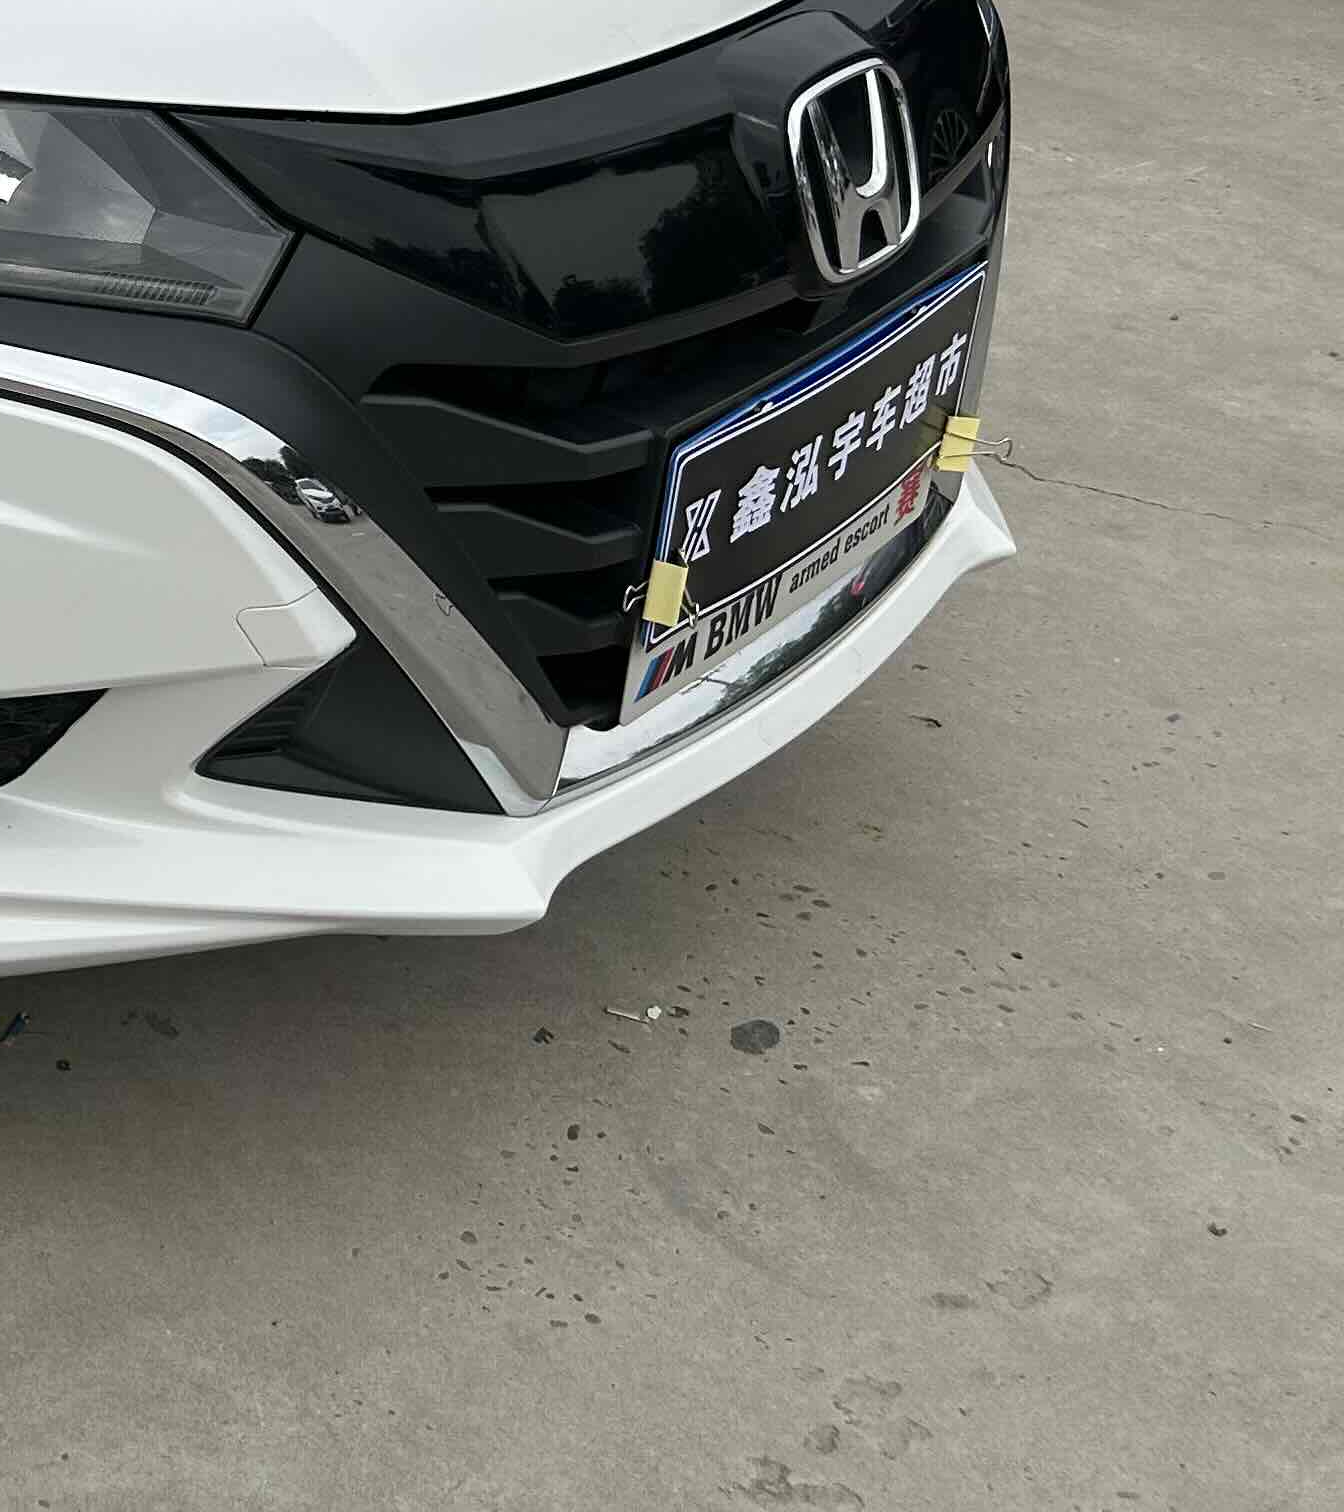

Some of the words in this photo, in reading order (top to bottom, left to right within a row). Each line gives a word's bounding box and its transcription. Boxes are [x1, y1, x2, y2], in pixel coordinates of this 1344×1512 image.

[729, 332, 967, 543] 鑫泓宇车超市
[703, 573, 784, 661] BMW
[788, 542, 840, 594] armed
[843, 503, 890, 554] escort
